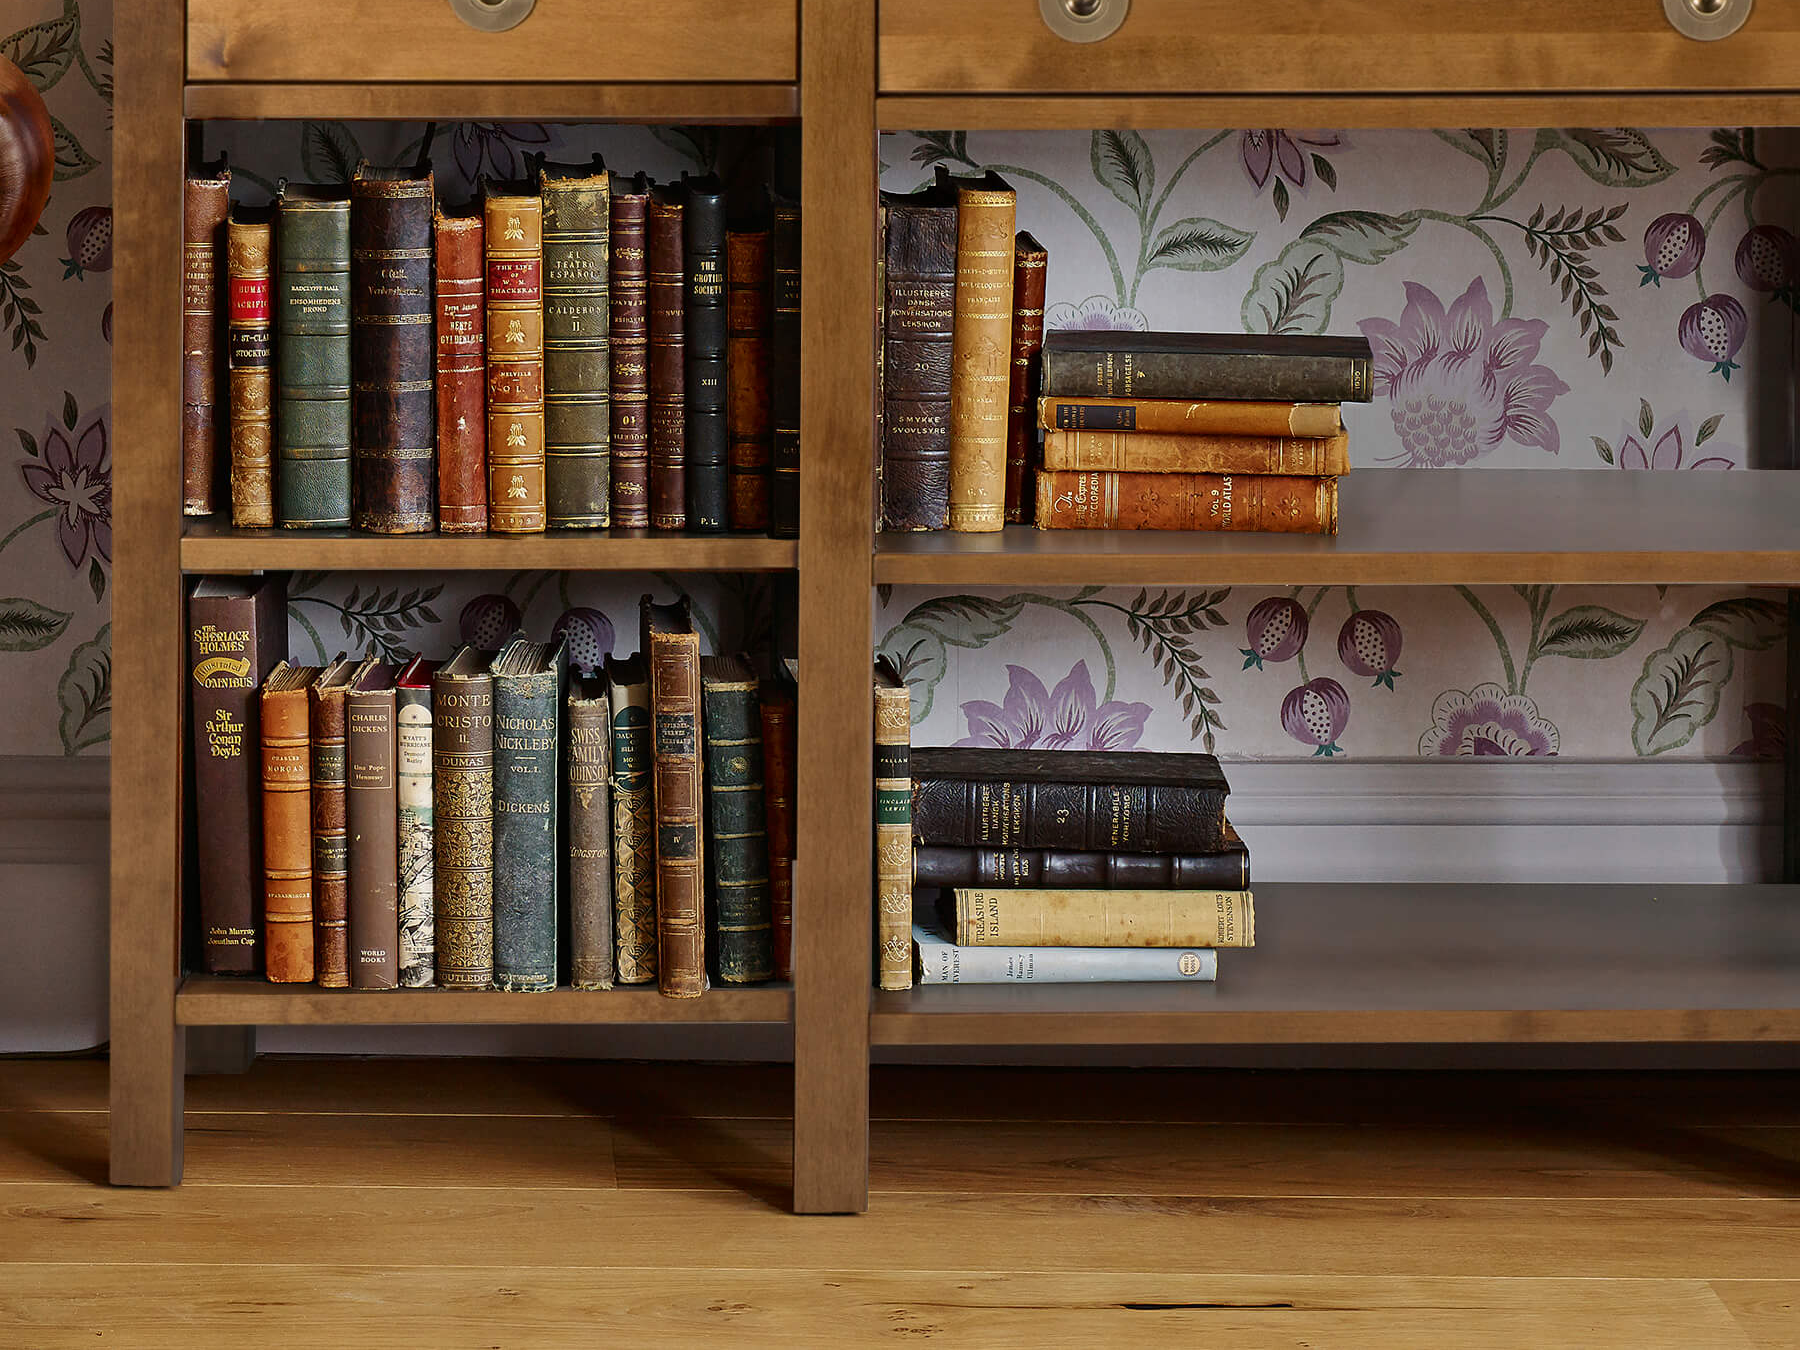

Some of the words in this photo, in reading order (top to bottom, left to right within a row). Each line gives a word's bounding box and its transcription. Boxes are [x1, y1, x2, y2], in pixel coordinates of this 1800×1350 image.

[568, 251, 581, 259] EL
[556, 261, 595, 269] TEATRO
[700, 261, 716, 270] THE
[693, 274, 723, 283] GROTIUS
[693, 285, 722, 295] SOCIETY
[548, 306, 601, 315] CALDERON
[890, 309, 952, 317] KONVERSATIONS
[902, 320, 941, 328] LEKSIKON
[914, 363, 930, 371] 20
[491, 385, 525, 393] VOL.
[1211, 489, 1219, 497] 9
[1222, 476, 1232, 501] ATLAS
[1054, 491, 1073, 513] The
[194, 630, 250, 642] SHERLOCK
[200, 641, 245, 654] HOLMES
[204, 677, 254, 688] OMNIBUS
[437, 694, 491, 707] MONTE
[215, 709, 232, 721] Sir
[351, 714, 388, 722] CHARLES
[436, 715, 492, 728] CRISTO
[206, 720, 244, 734] Arthur
[496, 714, 555, 730] NICHOLAS
[352, 725, 388, 733] DICKENS
[571, 727, 601, 744] SWISS
[209, 733, 241, 746] Conan
[496, 734, 556, 750] NICKLEBY
[211, 744, 241, 759] Doyle
[568, 745, 608, 763] AMILY
[442, 757, 484, 766] DUMAS
[267, 764, 304, 773] MORGAN
[368, 764, 386, 773] Pope-
[568, 764, 608, 781] OBINSON
[356, 773, 384, 782] Hennessy
[498, 800, 550, 814] DICKENS
[1056, 809, 1070, 824] 23
[1111, 789, 1120, 846] VENERABILE
[1122, 794, 1131, 842] YORITOMO
[1216, 894, 1224, 913] LOUIS
[975, 892, 985, 943] TREASURE
[989, 897, 999, 937] ISLAND
[1225, 896, 1233, 941] STEVENSON
[209, 927, 227, 935] John
[229, 927, 255, 936] Murray
[1217, 915, 1225, 944] ROBERT
[208, 937, 239, 946] Jonathan
[941, 951, 949, 962] OF
[941, 965, 949, 981] MAN
[953, 949, 961, 985] EVEREST
